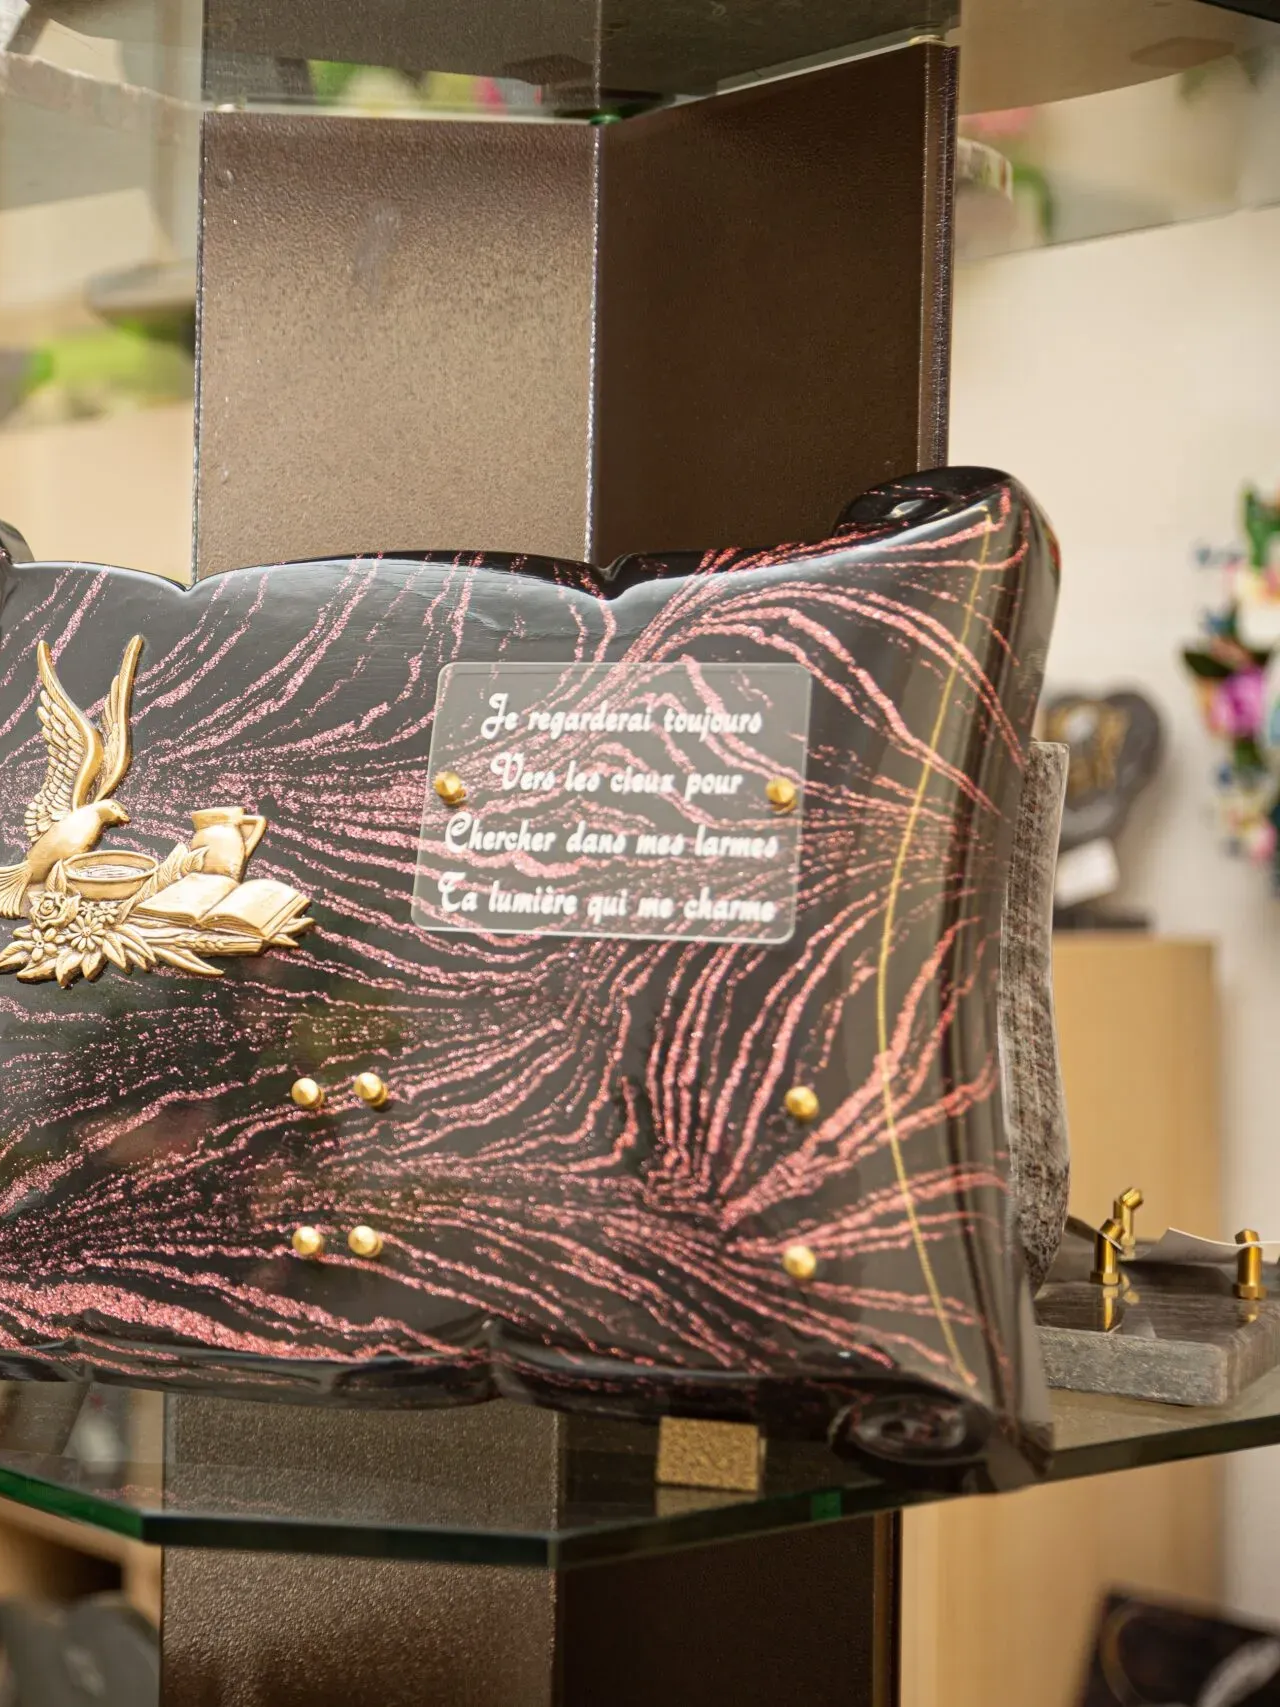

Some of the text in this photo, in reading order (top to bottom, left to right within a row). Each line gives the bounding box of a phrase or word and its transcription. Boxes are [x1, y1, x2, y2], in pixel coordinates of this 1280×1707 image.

[482, 693, 762, 742] Je regarderai toujours
[491, 752, 743, 801] Vers les cieux pour
[445, 811, 779, 858] Chercher dans mes larmes
[489, 880, 578, 915] lumière
[587, 891, 628, 924] qui
[638, 898, 673, 918] me
[684, 886, 776, 922] charme
